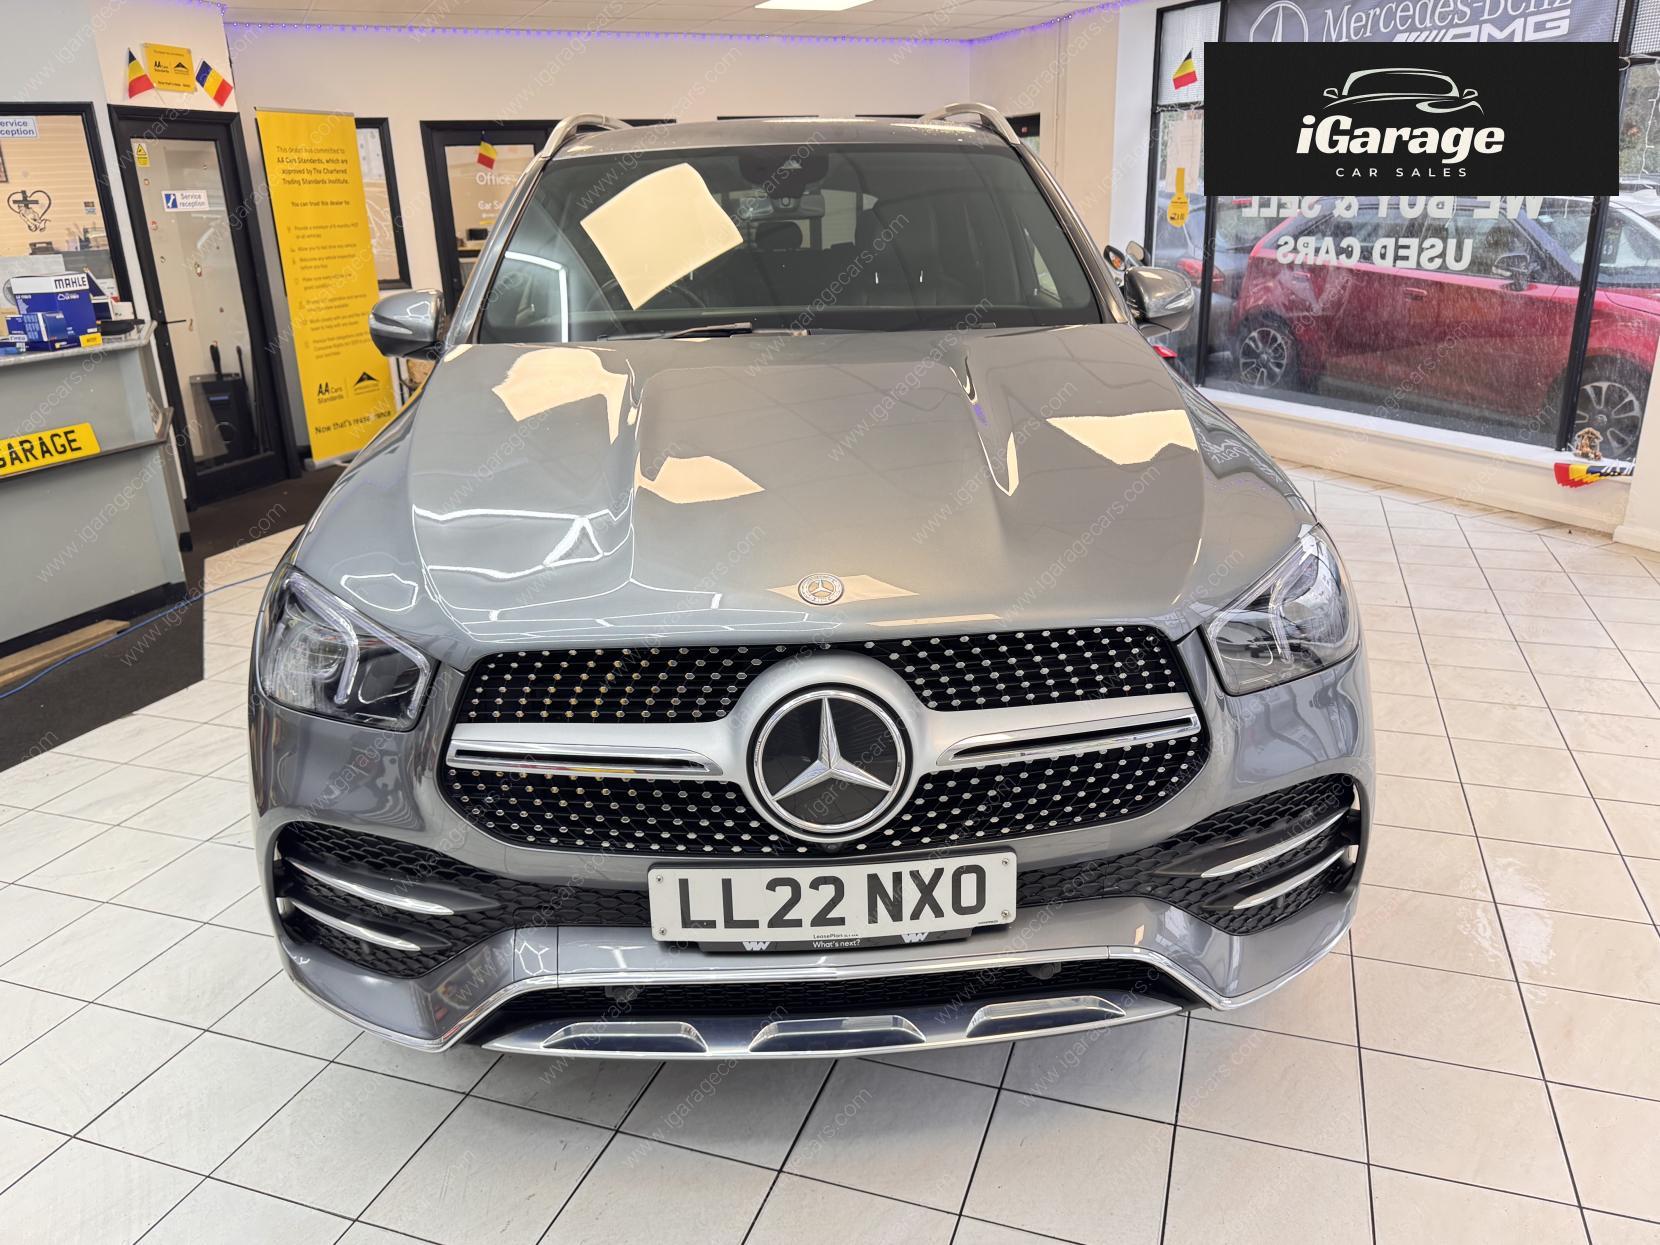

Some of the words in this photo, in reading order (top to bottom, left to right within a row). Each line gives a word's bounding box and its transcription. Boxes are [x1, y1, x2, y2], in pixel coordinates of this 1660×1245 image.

[476, 172, 512, 185] Office
[54, 278, 87, 289] MAHLE
[354, 411, 391, 425] reassance
[678, 875, 846, 929] LL22
[867, 864, 987, 925] NXO
[812, 940, 839, 949] What's
[840, 938, 861, 947] next?
